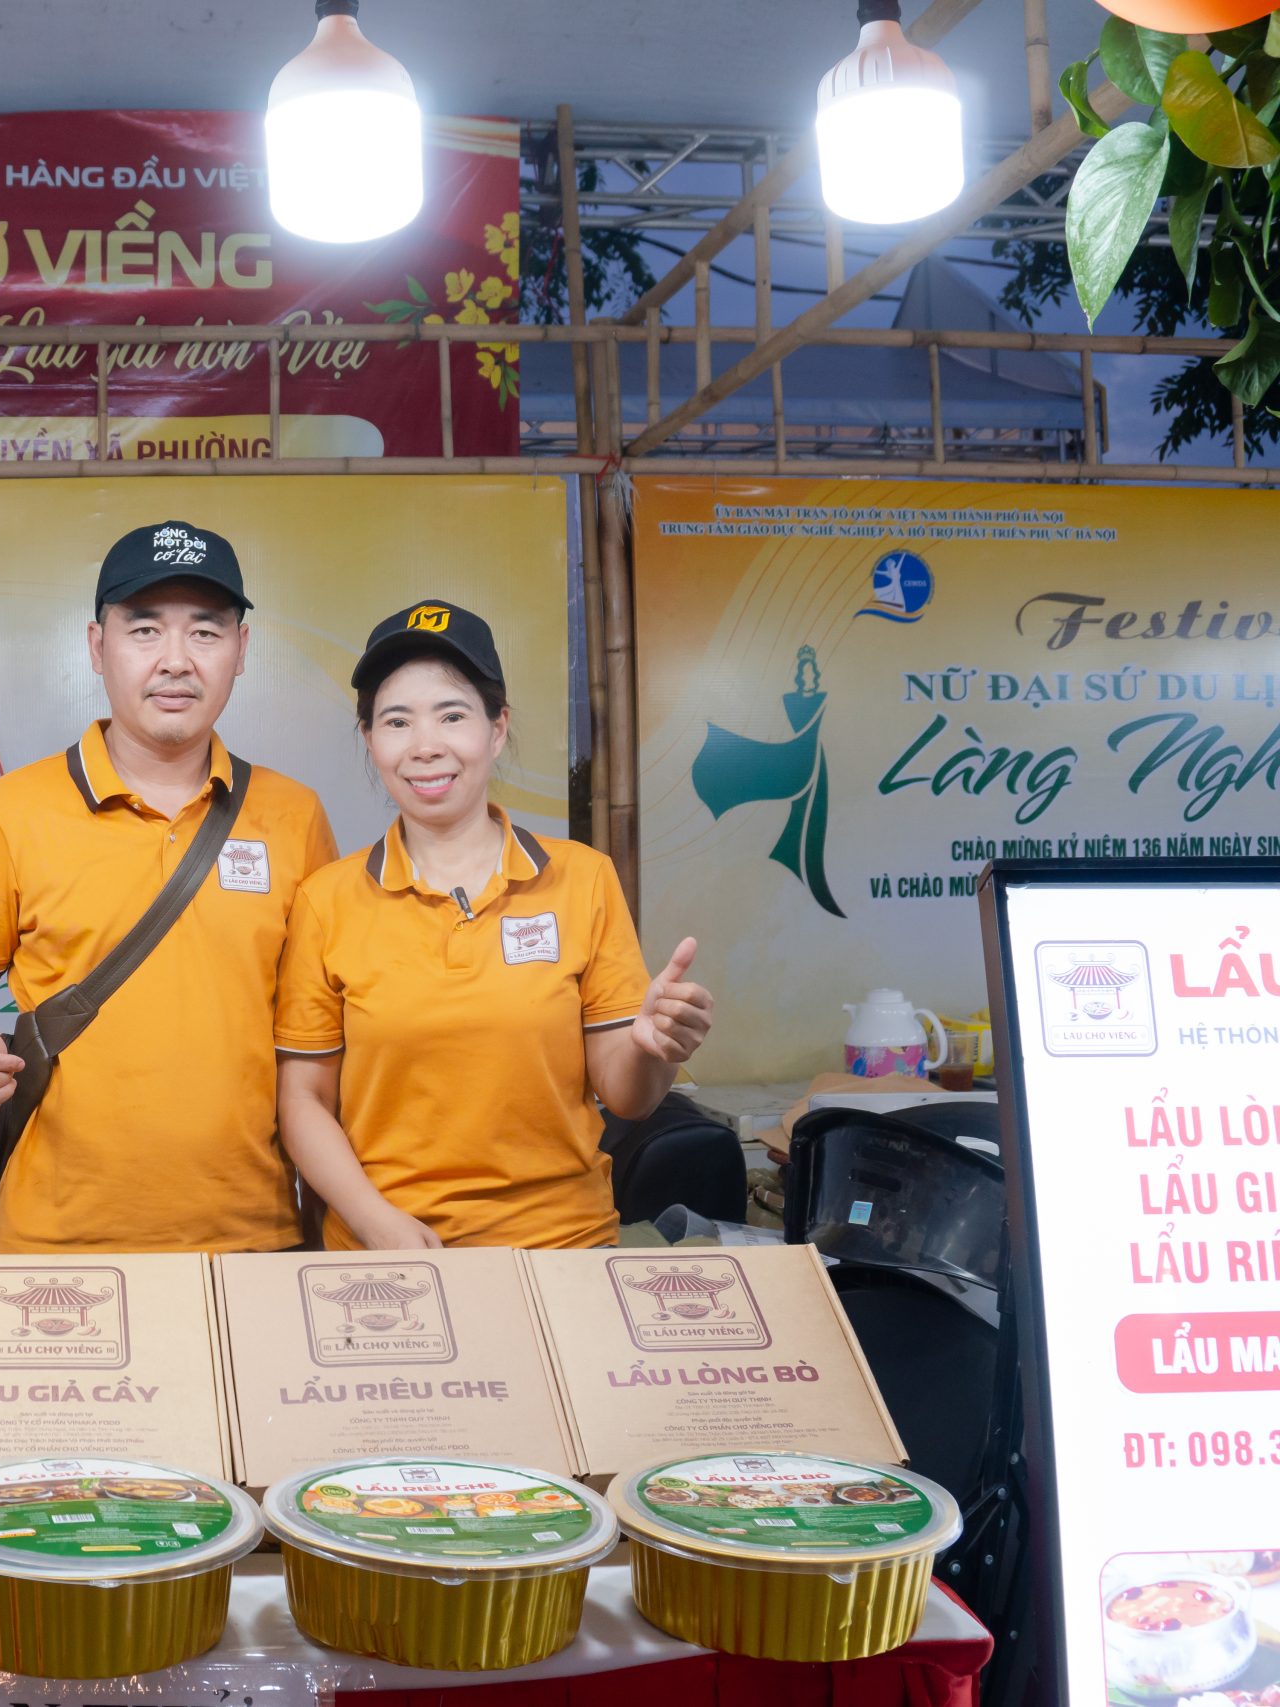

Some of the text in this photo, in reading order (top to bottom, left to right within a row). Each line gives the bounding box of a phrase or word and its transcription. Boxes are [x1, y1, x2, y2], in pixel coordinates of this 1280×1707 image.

[6, 157, 104, 188] HÀNG
[112, 154, 186, 189] ĐẦU
[24, 199, 273, 290] VIỀNG
[736, 507, 761, 518] BAN
[921, 511, 948, 521] NAM
[1023, 510, 1039, 522] HÀ
[1043, 511, 1064, 524] NỘI
[153, 526, 188, 540] SỐNG
[153, 536, 207, 551] MỘT ĐỜI
[1016, 592, 1280, 650] Festiv
[905, 666, 1278, 709] NỮ ĐẠI SỨ DU LỊ
[878, 711, 1280, 825] Làng Ngh
[951, 834, 997, 861] CHÀO
[1002, 834, 1053, 860] MỪNG
[1132, 838, 1161, 858] 136
[1166, 833, 1204, 858] NĂM
[1210, 833, 1252, 857] NGÀY
[1258, 838, 1280, 857] SIN
[870, 872, 979, 898] VÀ CHÀO MỪ
[1170, 925, 1280, 998] LẨU
[1125, 1087, 1280, 1148] LẨU LÒ
[1140, 1154, 1278, 1215] LẨU GI
[1130, 1222, 1210, 1284] LẨU
[680, 1327, 707, 1339] CHỢ
[1152, 1321, 1280, 1375] LẨU MA
[35, 1344, 64, 1356] CHỢ
[27, 1379, 85, 1403] GIẢ
[92, 1375, 161, 1403] CẦY
[608, 1359, 820, 1388] LẨU LÒNG BÒ
[279, 1376, 510, 1405] LẨU RIÊU GHẸ
[1124, 1430, 1280, 1468] ĐT: 098.3
[355, 1482, 399, 1493] LẨU
